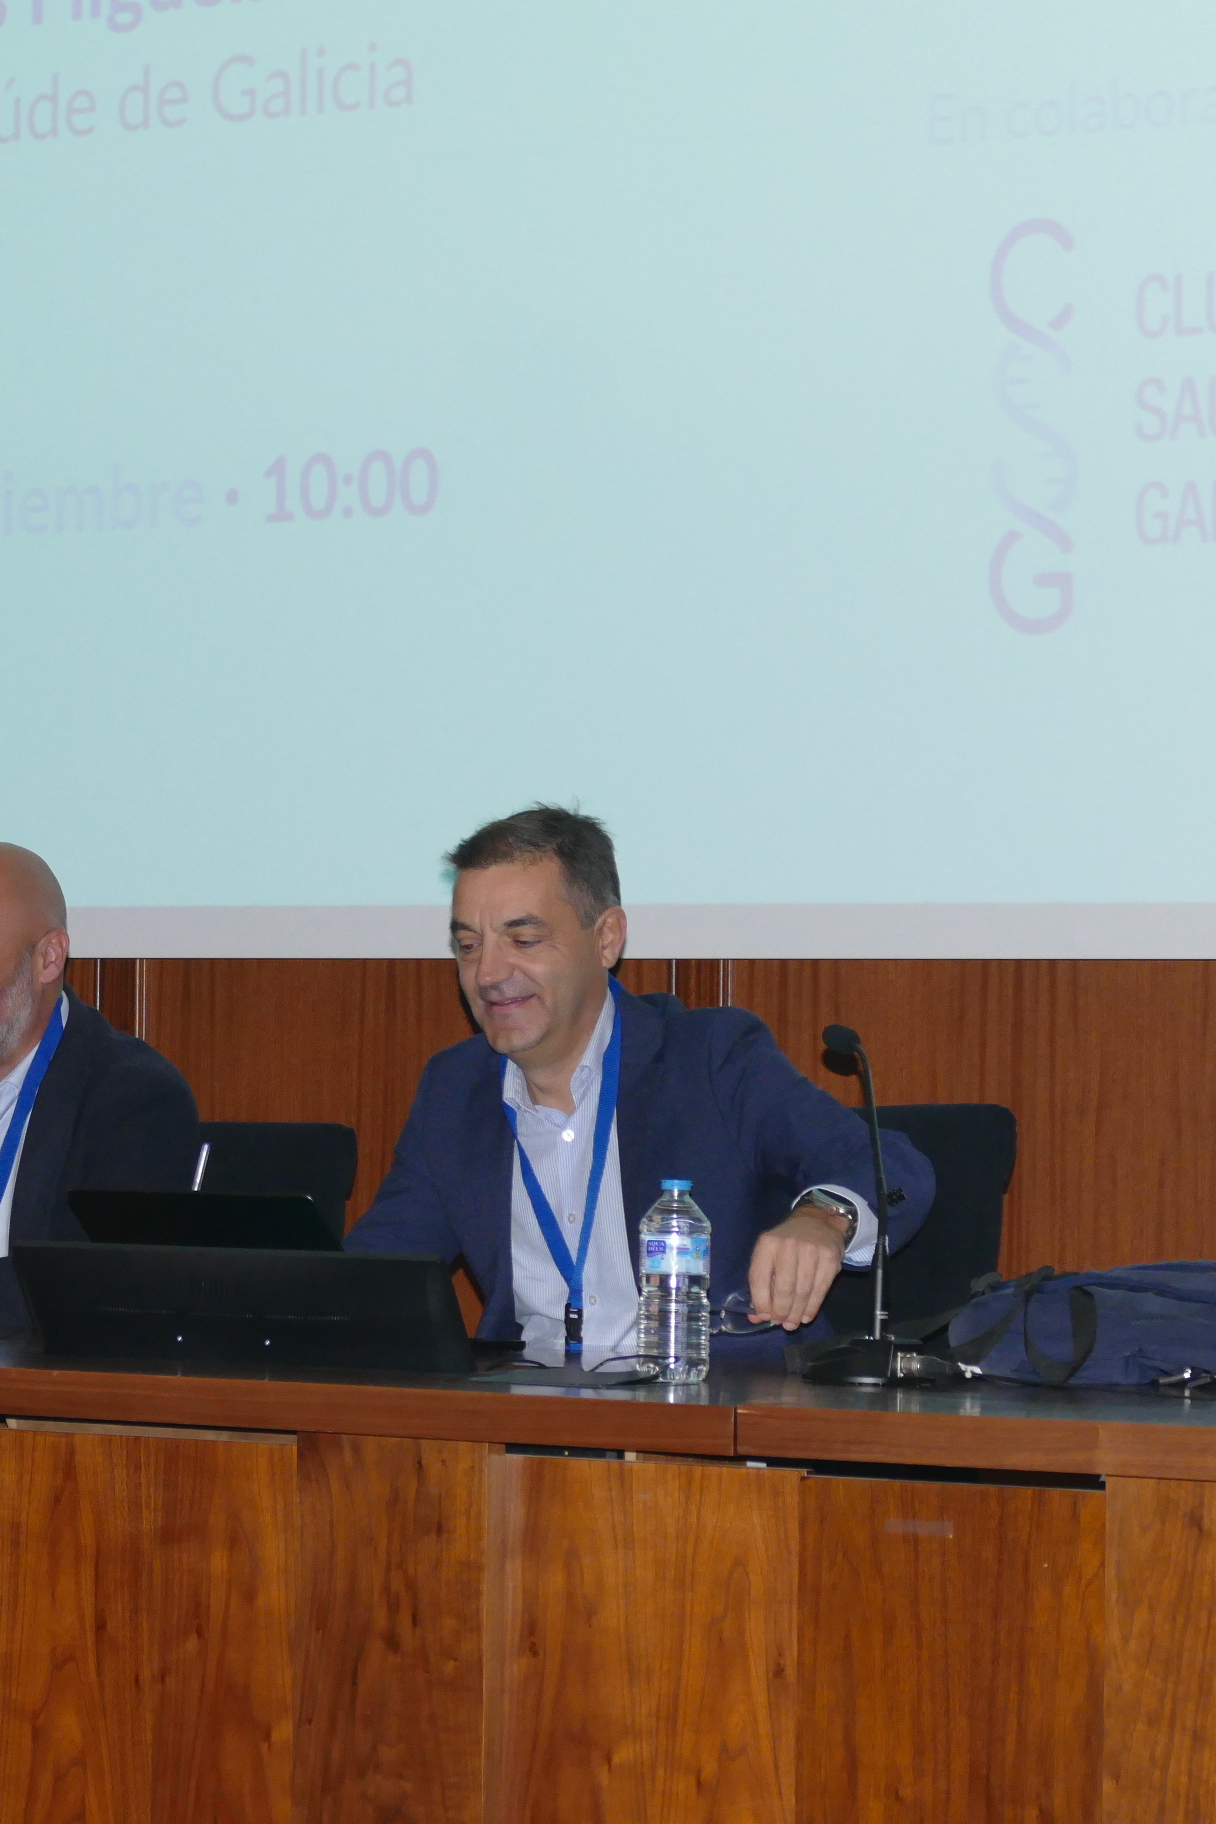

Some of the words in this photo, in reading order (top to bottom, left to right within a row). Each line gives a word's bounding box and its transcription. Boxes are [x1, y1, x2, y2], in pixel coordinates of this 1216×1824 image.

[117, 63, 190, 133] de
[211, 41, 416, 123] Galicia
[928, 91, 988, 145] En
[263, 446, 440, 523] 10:00
[1136, 480, 1216, 546] GA
